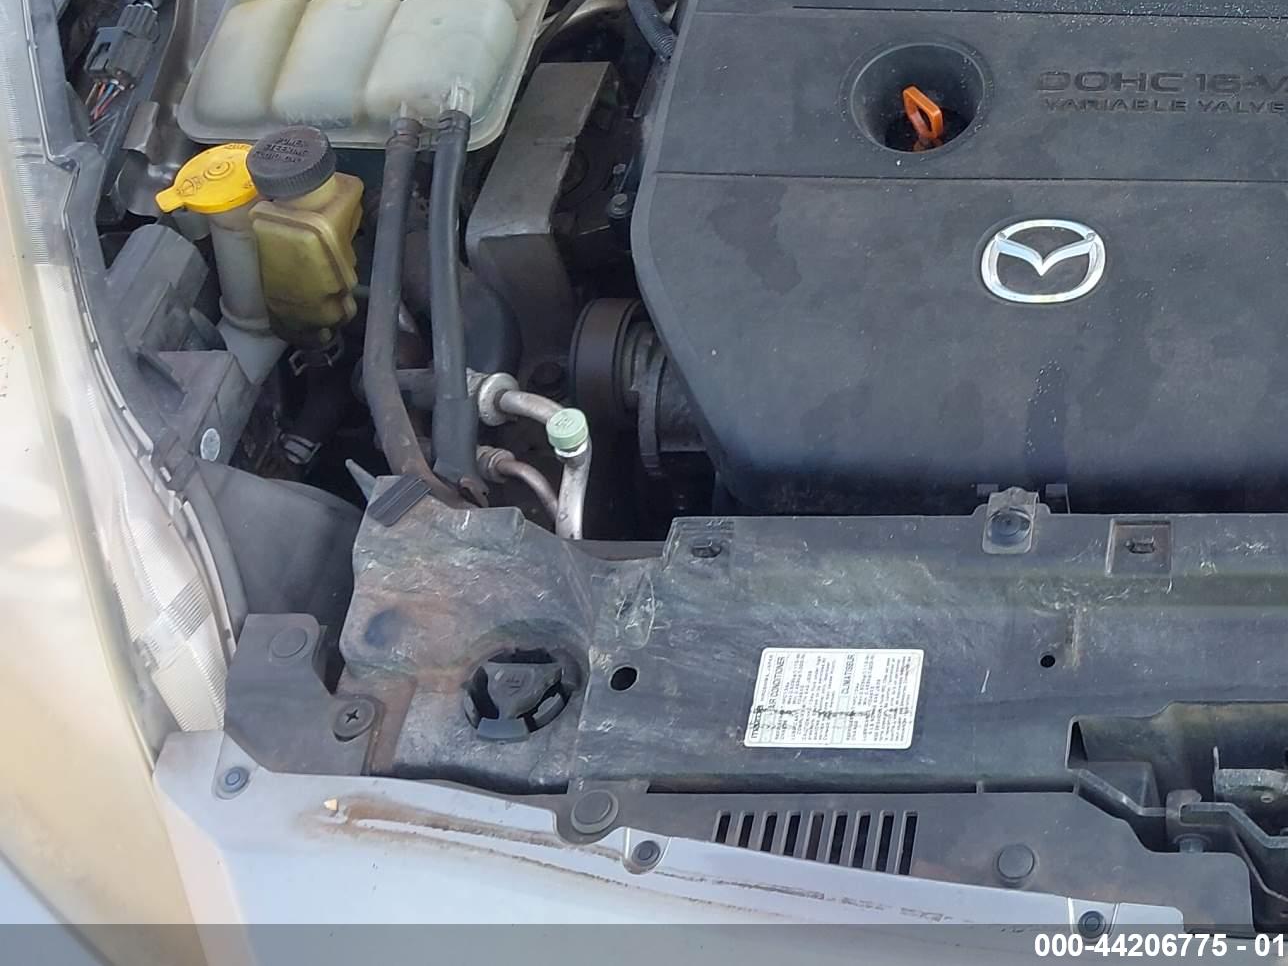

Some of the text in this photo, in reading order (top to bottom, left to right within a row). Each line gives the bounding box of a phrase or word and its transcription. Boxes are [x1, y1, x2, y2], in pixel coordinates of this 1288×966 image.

[1036, 71, 1186, 93] DOHC
[1043, 98, 1188, 114] VARIABLE
[1197, 99, 1287, 115] VALVE
[770, 656, 785, 696] CONDITIONER
[750, 704, 763, 738] mazda
